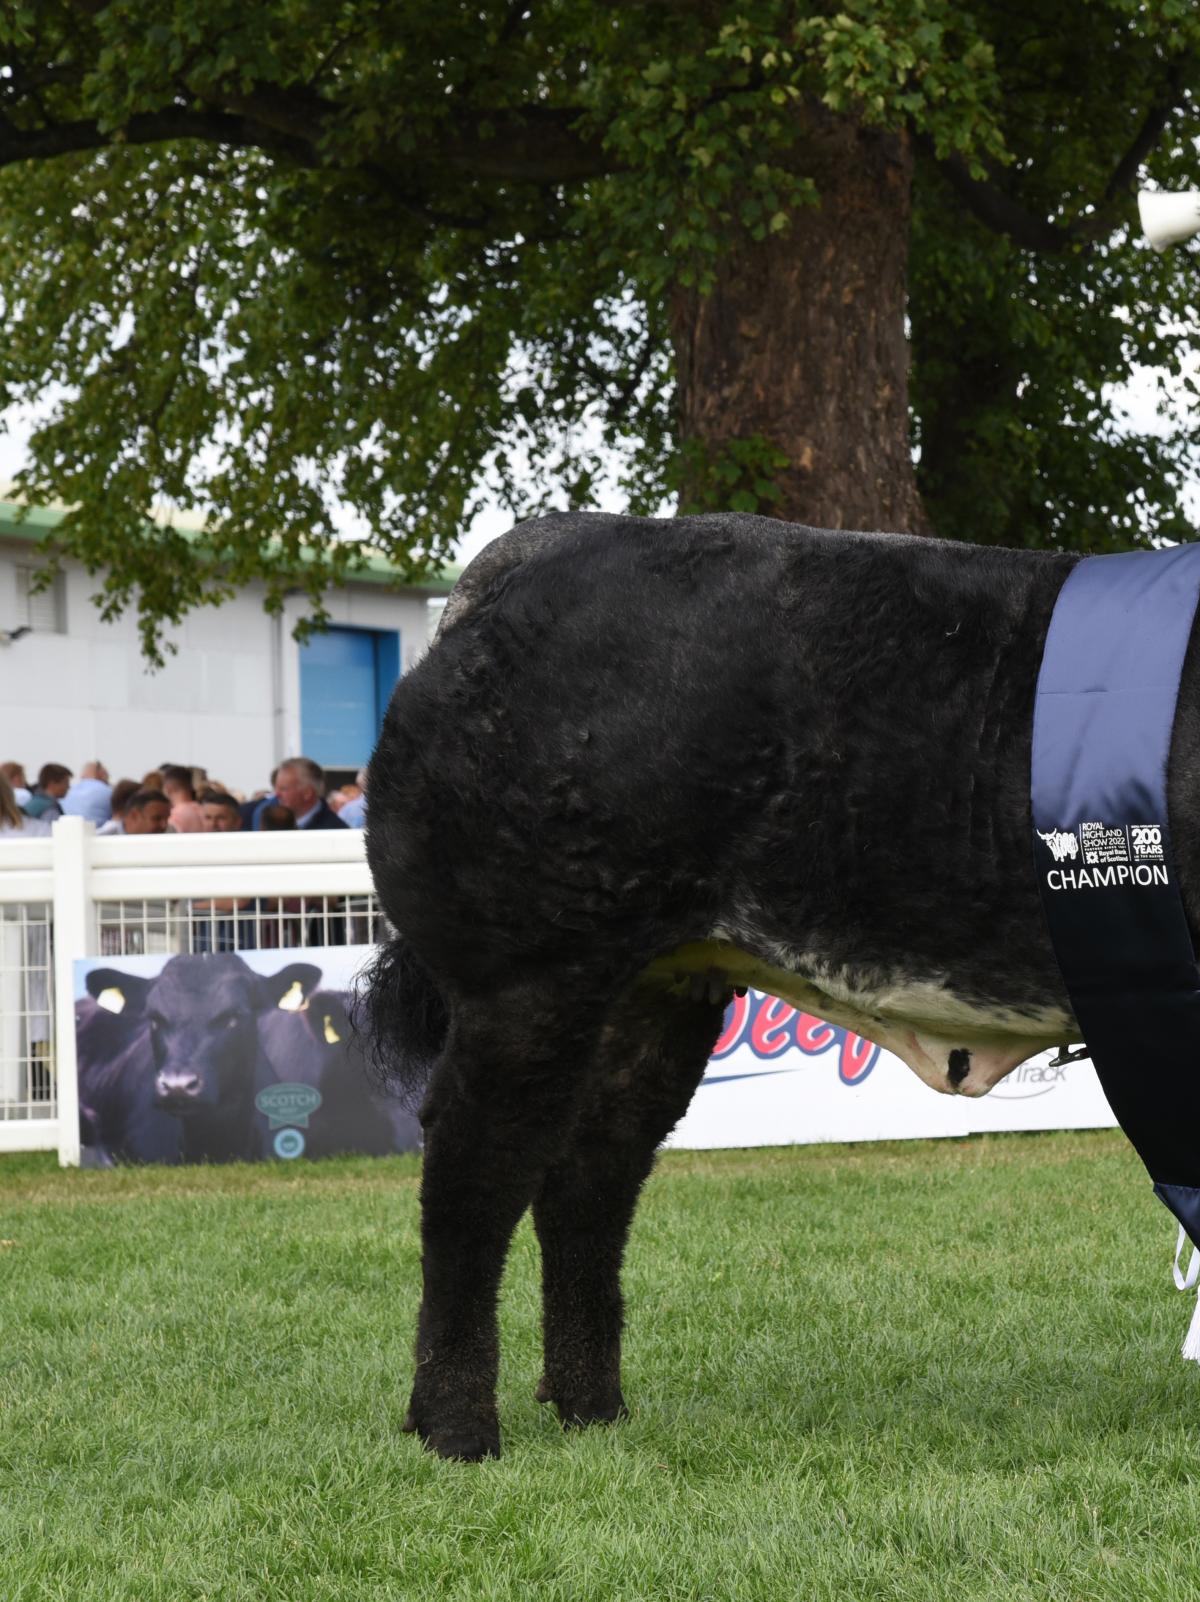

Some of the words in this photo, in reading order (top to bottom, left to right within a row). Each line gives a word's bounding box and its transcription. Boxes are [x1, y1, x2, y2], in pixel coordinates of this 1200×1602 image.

[1082, 822, 1104, 831] ROYAL
[1083, 829, 1122, 839] HIGHLAND
[1132, 828, 1161, 845] 200
[1083, 839, 1107, 848] SHOW
[1133, 844, 1164, 855] YEARS
[1047, 864, 1169, 890] CHAMPION
[261, 1094, 316, 1108] SCOTCH
